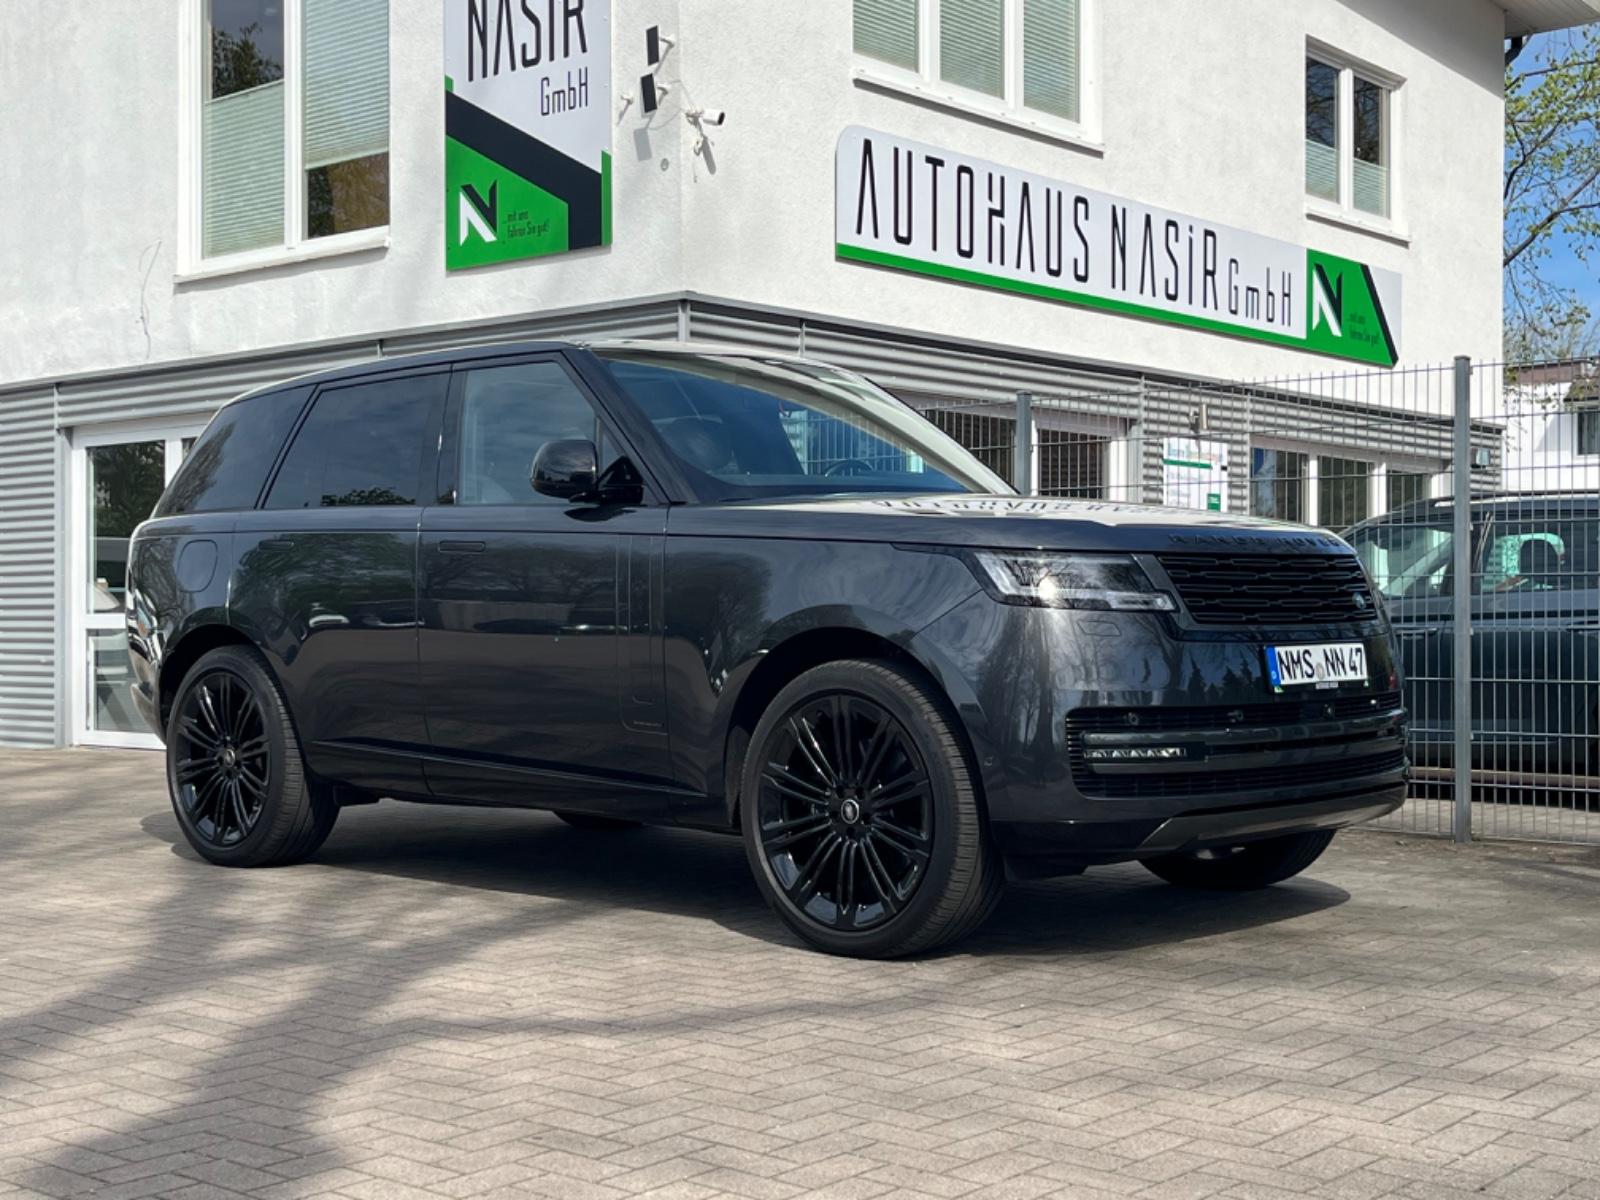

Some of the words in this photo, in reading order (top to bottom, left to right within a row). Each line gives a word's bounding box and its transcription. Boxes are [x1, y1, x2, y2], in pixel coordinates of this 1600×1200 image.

[540, 66, 588, 116] GmbH
[856, 138, 1089, 283] AUTOHAUS
[1228, 257, 1292, 327] GmbH
[1277, 649, 1315, 680] NMS
[1323, 648, 1347, 677] NN
[1348, 647, 1363, 676] 47
